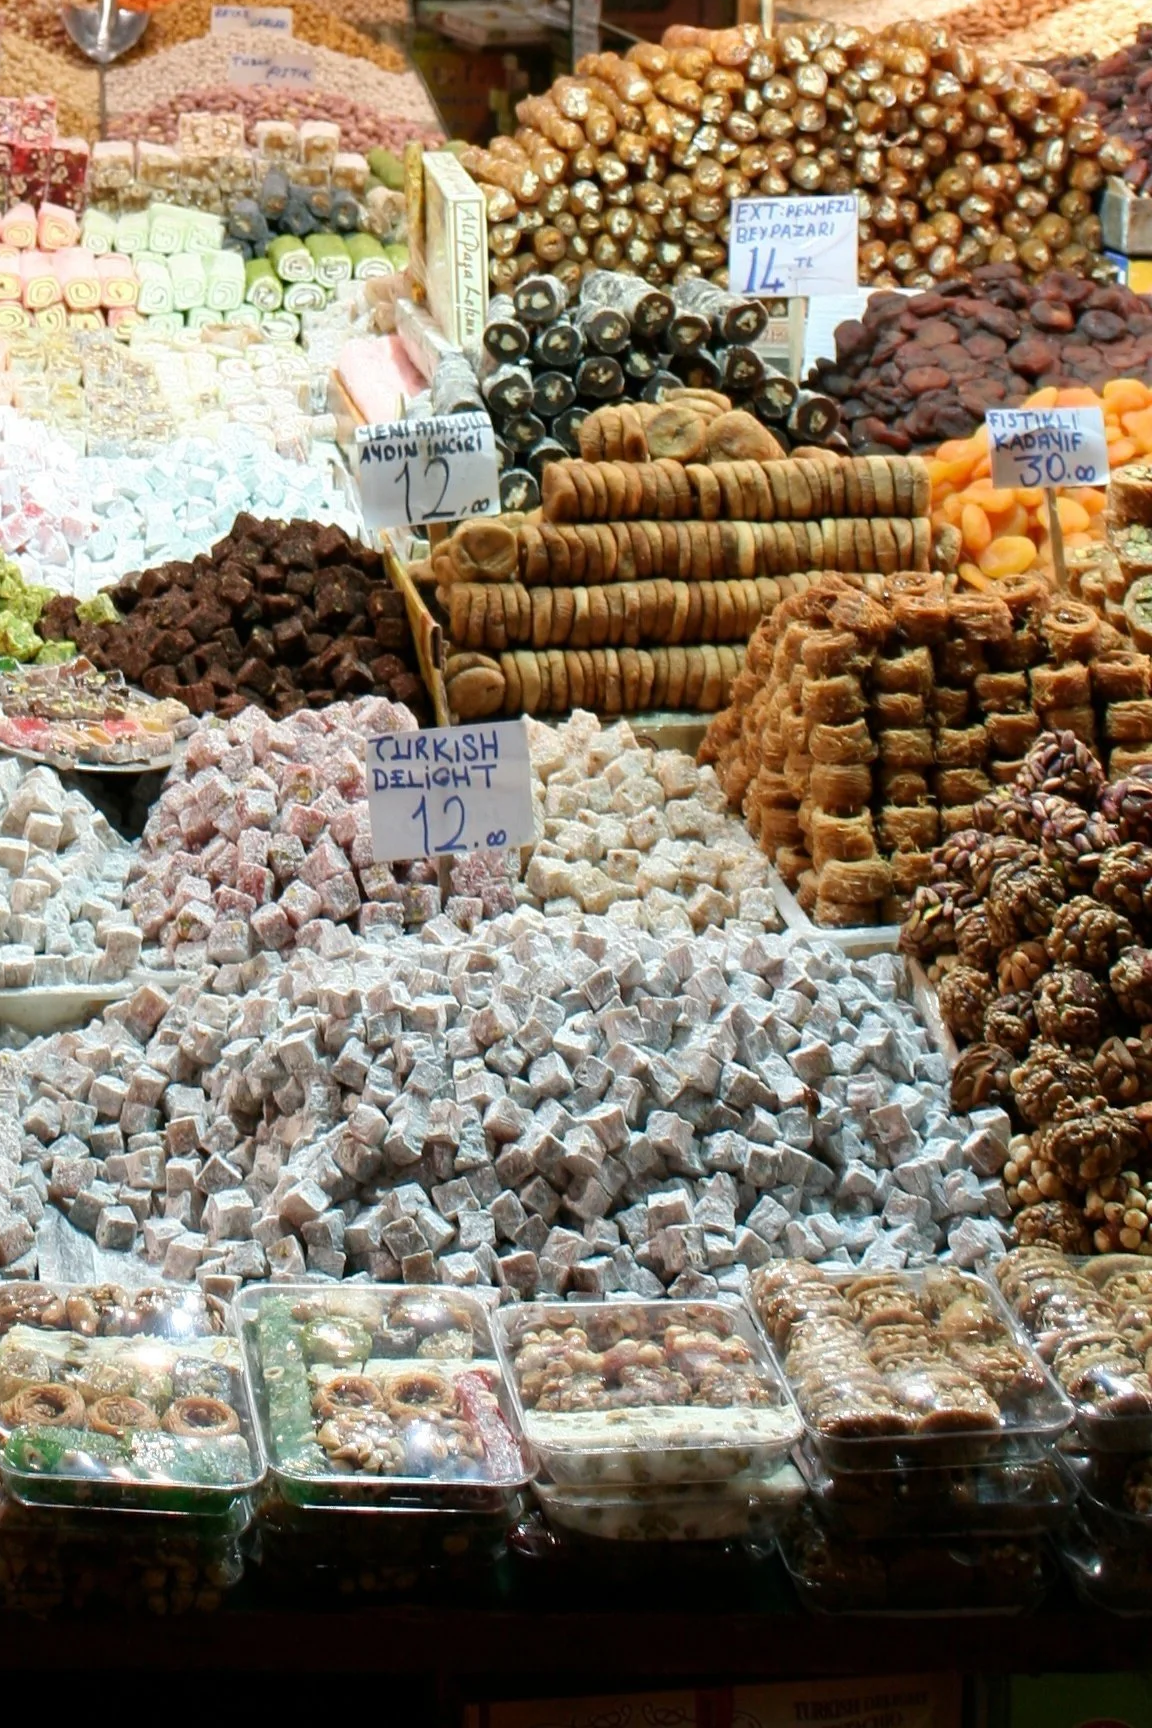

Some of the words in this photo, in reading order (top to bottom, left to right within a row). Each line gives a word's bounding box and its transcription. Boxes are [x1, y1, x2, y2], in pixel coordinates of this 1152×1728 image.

[736, 223, 835, 244] BEYPAZARI
[988, 412, 1077, 430] FISTIKLI
[359, 440, 418, 466] AYDIN
[993, 432, 1082, 453] KADAYIF
[368, 729, 499, 764] TURKISH
[793, 1696, 861, 1721] TURKISH
